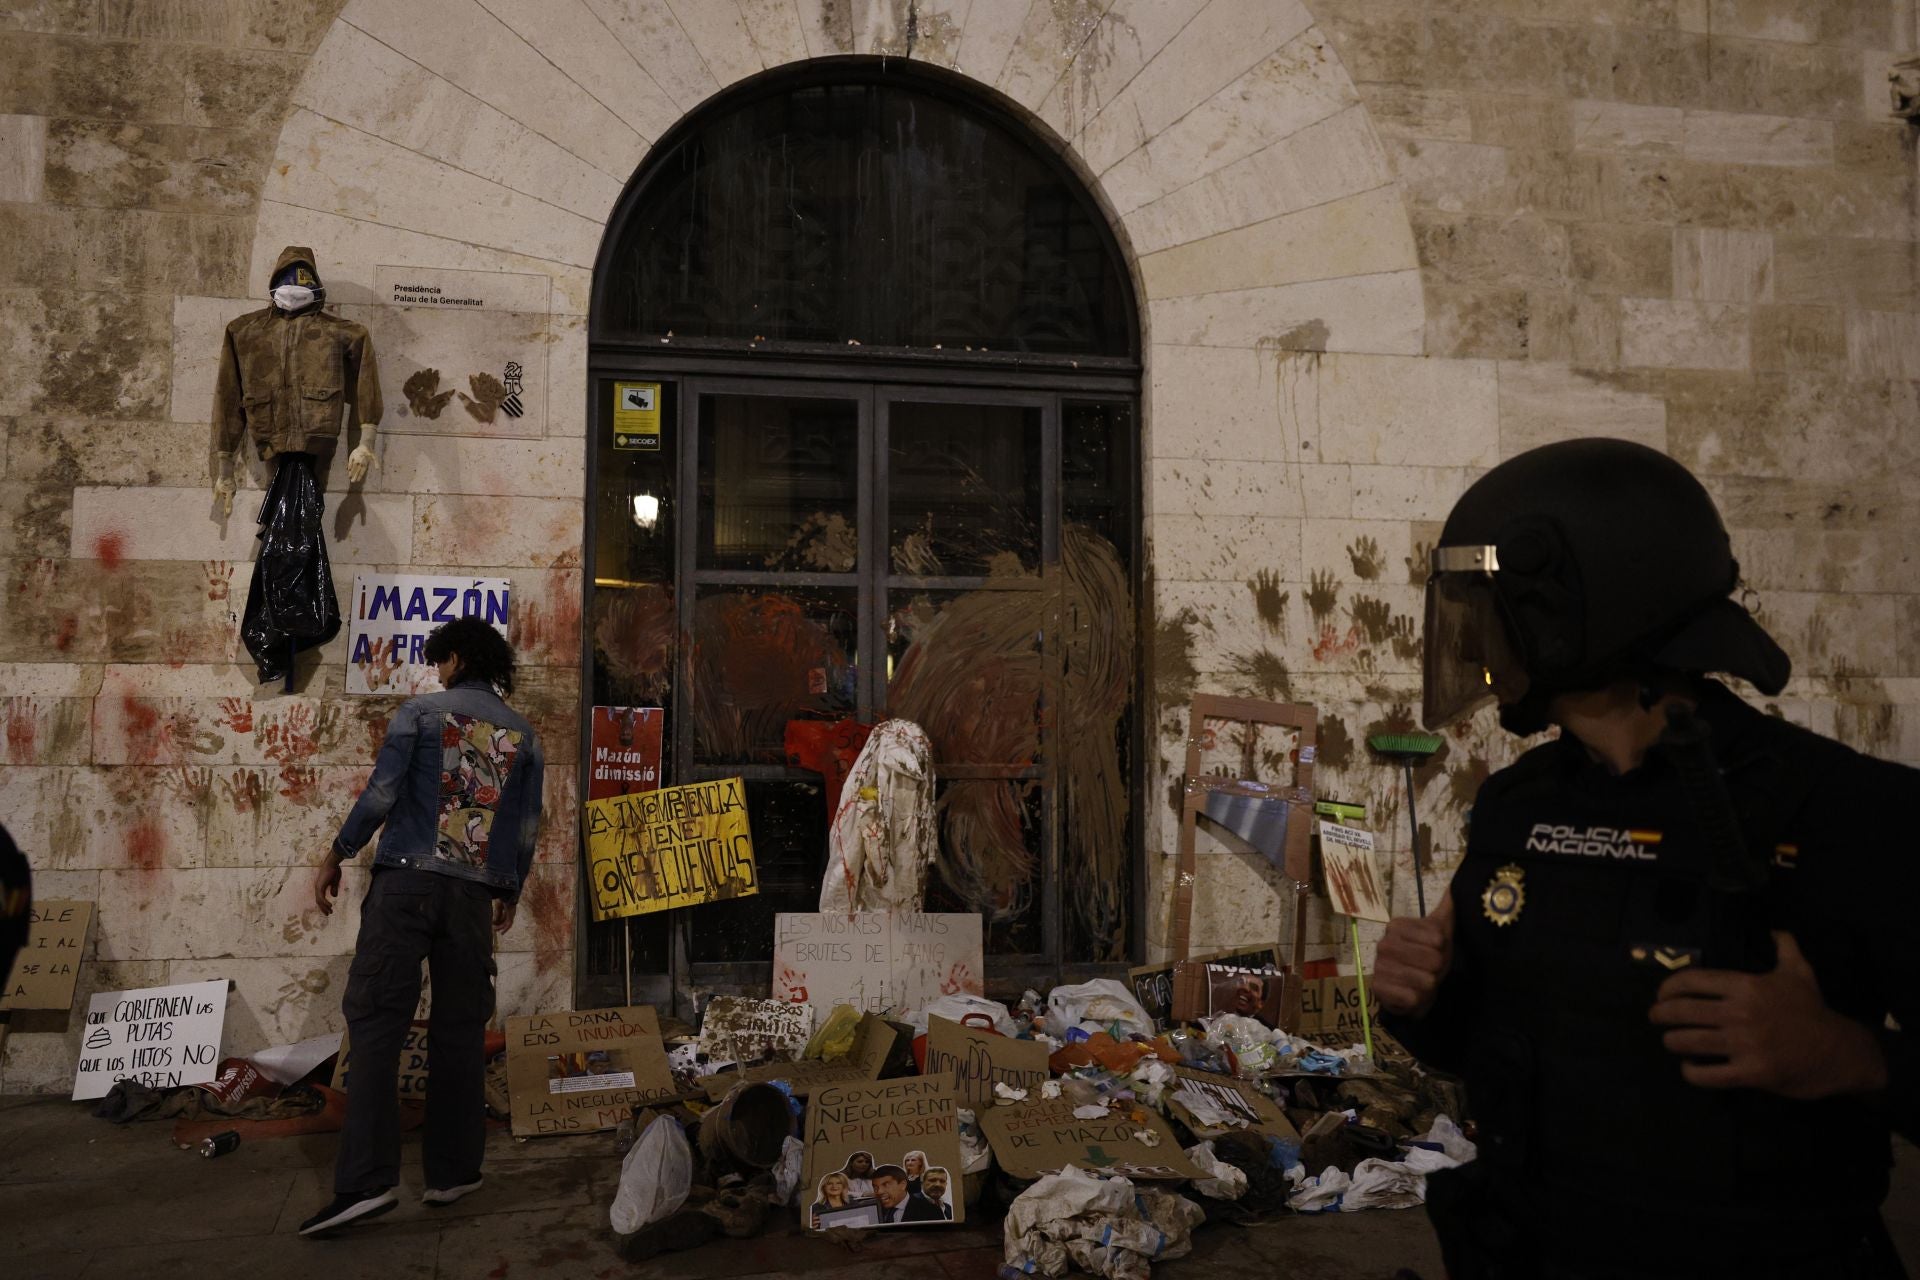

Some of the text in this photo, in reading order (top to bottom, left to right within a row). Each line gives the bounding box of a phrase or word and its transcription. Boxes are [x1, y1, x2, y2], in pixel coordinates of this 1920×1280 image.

[394, 284, 441, 294] Presidència
[394, 294, 483, 307] Palau de la Generalitat
[351, 633, 373, 664] A
[595, 747, 641, 764] Mazón
[594, 764, 655, 782] dimissió
[1530, 823, 1633, 843] POLICIA
[1525, 837, 1658, 860] NACIONAL
[900, 914, 949, 935] MANS
[796, 943, 852, 962] BRUTES
[865, 944, 885, 963] DE
[87, 995, 213, 1025] QUE GOBIERNEN LAS
[126, 1021, 173, 1043] PUTAS
[529, 1011, 624, 1032] LA DANA
[523, 1023, 647, 1047] ENS INUNDA
[79, 1043, 216, 1072] QUE LOS HIJOS NO
[530, 1087, 673, 1116] LA NEGLIGENCIA
[819, 1082, 939, 1106] GOVERN
[820, 1098, 953, 1124] NEGLIGENT
[537, 1116, 581, 1133] ENS
[813, 1115, 955, 1145] A PICASSENT
[1010, 1133, 1041, 1149] DE
